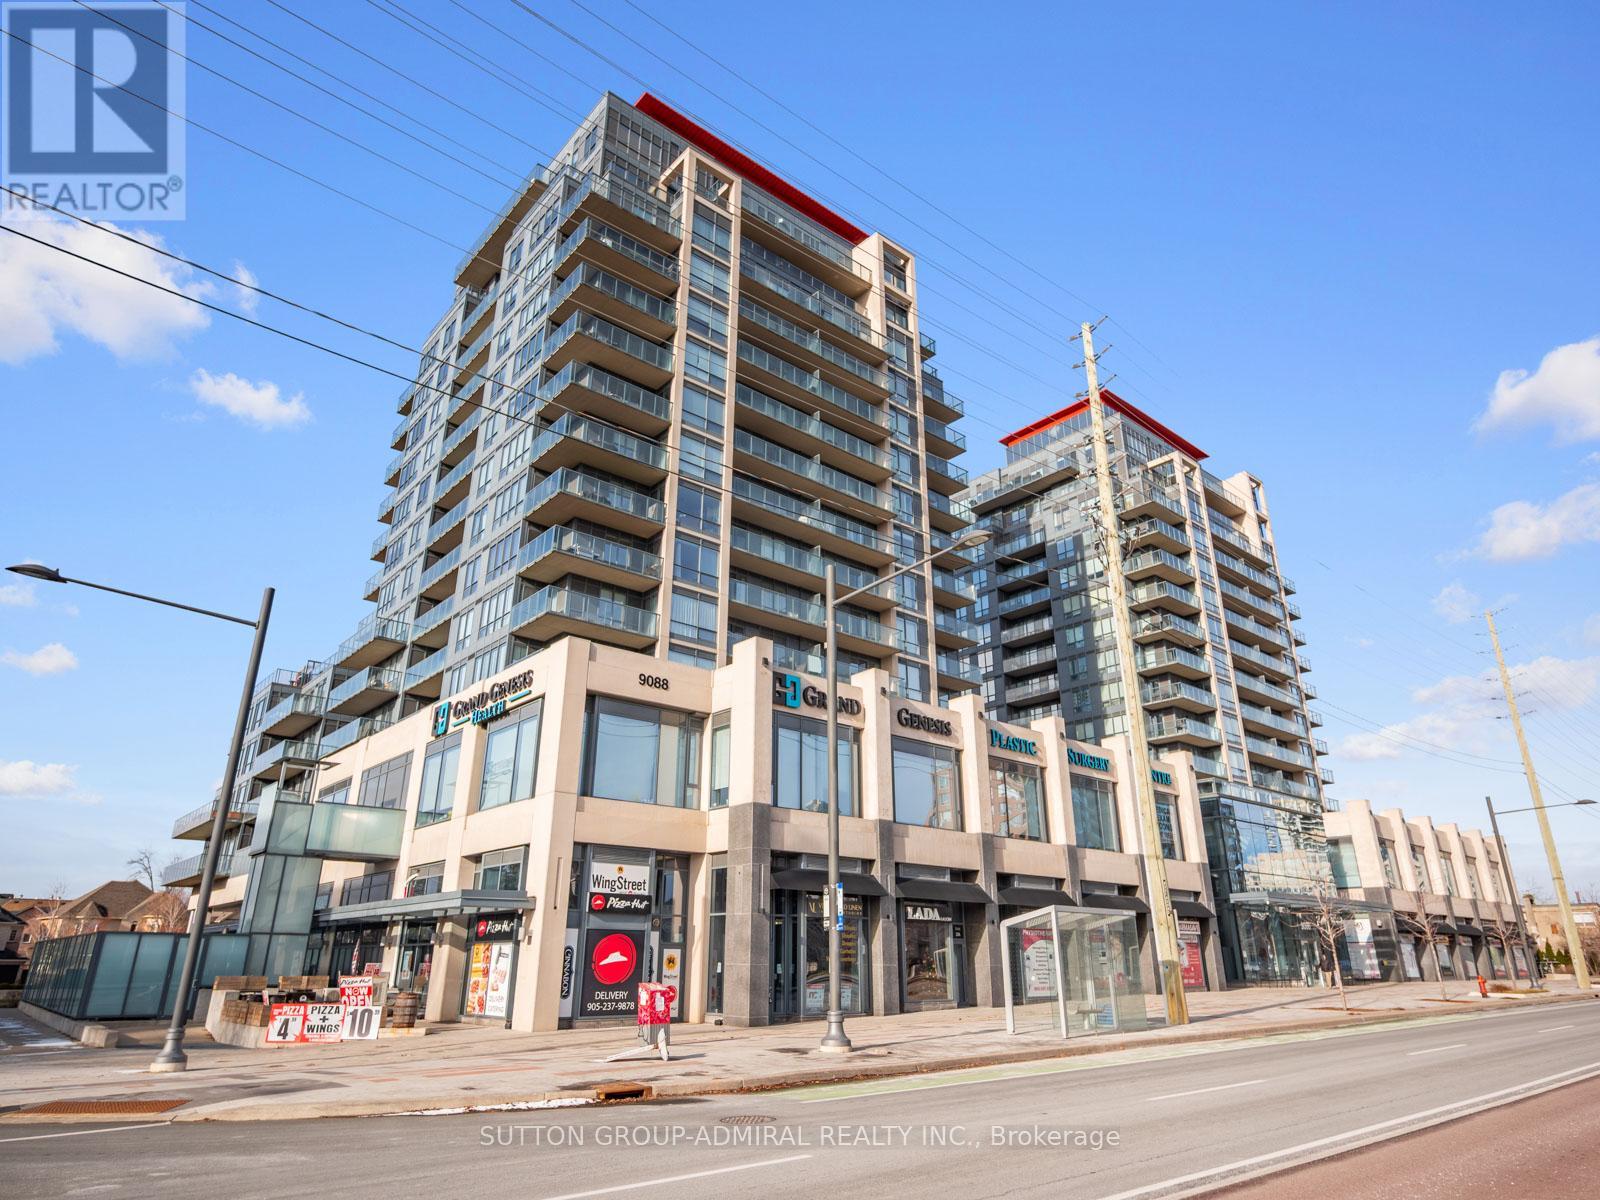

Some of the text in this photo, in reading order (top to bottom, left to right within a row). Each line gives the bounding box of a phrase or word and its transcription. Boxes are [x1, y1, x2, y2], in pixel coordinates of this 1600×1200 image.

[489, 669, 534, 702] GENESIS
[638, 673, 669, 691] 9088
[471, 699, 507, 726] HEALTH
[802, 685, 1173, 785] GRND GENESIS PLASTIC SURGERY NTRE
[592, 874, 647, 892] WingStreet
[606, 896, 650, 909] Pizza Hut
[906, 906, 941, 921] LADA
[486, 919, 515, 935] Pizza Hut
[561, 948, 573, 997] CINNABON
[345, 987, 369, 996] NOW
[594, 991, 629, 1001] DELIVERY
[341, 995, 373, 1007] OPEN
[587, 1001, 635, 1012] 905-237-9878
[281, 1005, 305, 1016] PIZZA
[310, 1005, 341, 1015] PIZZA
[276, 1017, 290, 1040] 4
[306, 1024, 340, 1034] WINGS
